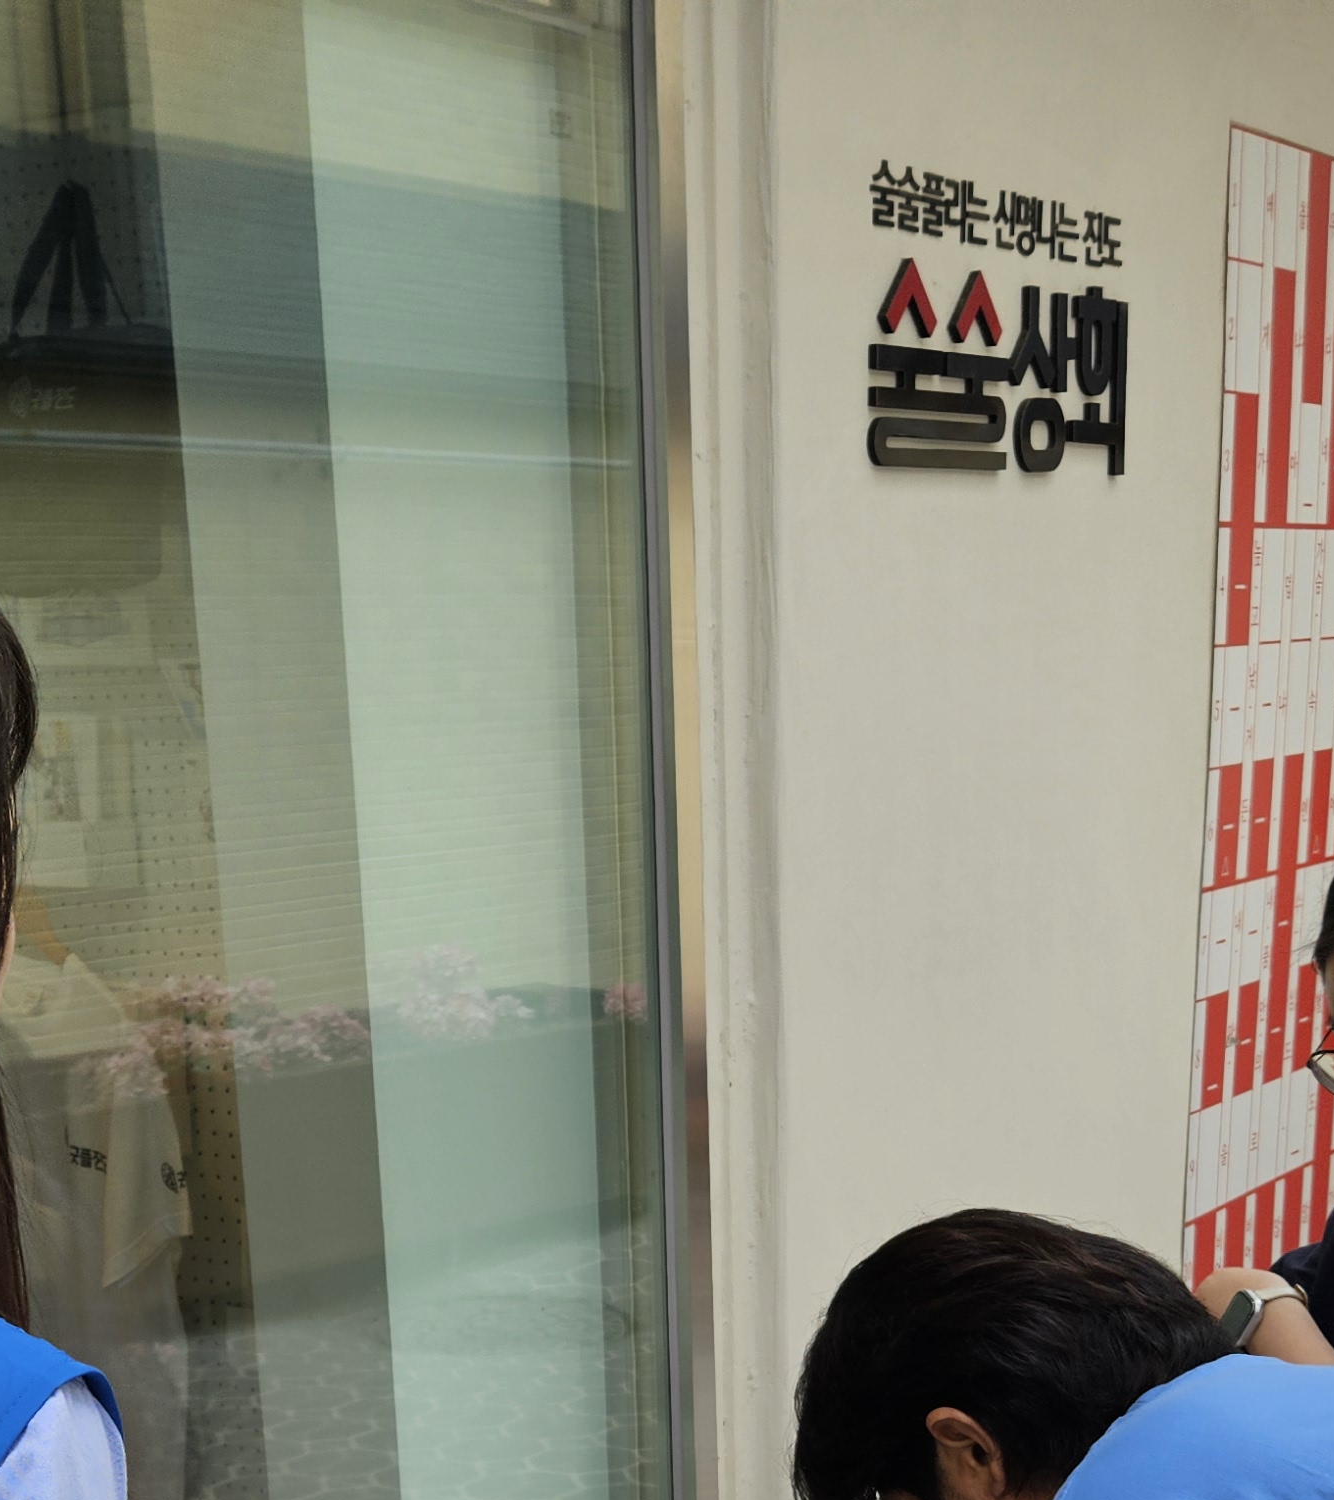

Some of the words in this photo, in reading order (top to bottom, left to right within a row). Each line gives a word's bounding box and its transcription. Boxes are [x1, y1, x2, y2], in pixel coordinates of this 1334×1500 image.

[869, 159, 990, 246] 술술풀리는
[993, 190, 1080, 263] 신명나는
[1082, 210, 1123, 268] 진도
